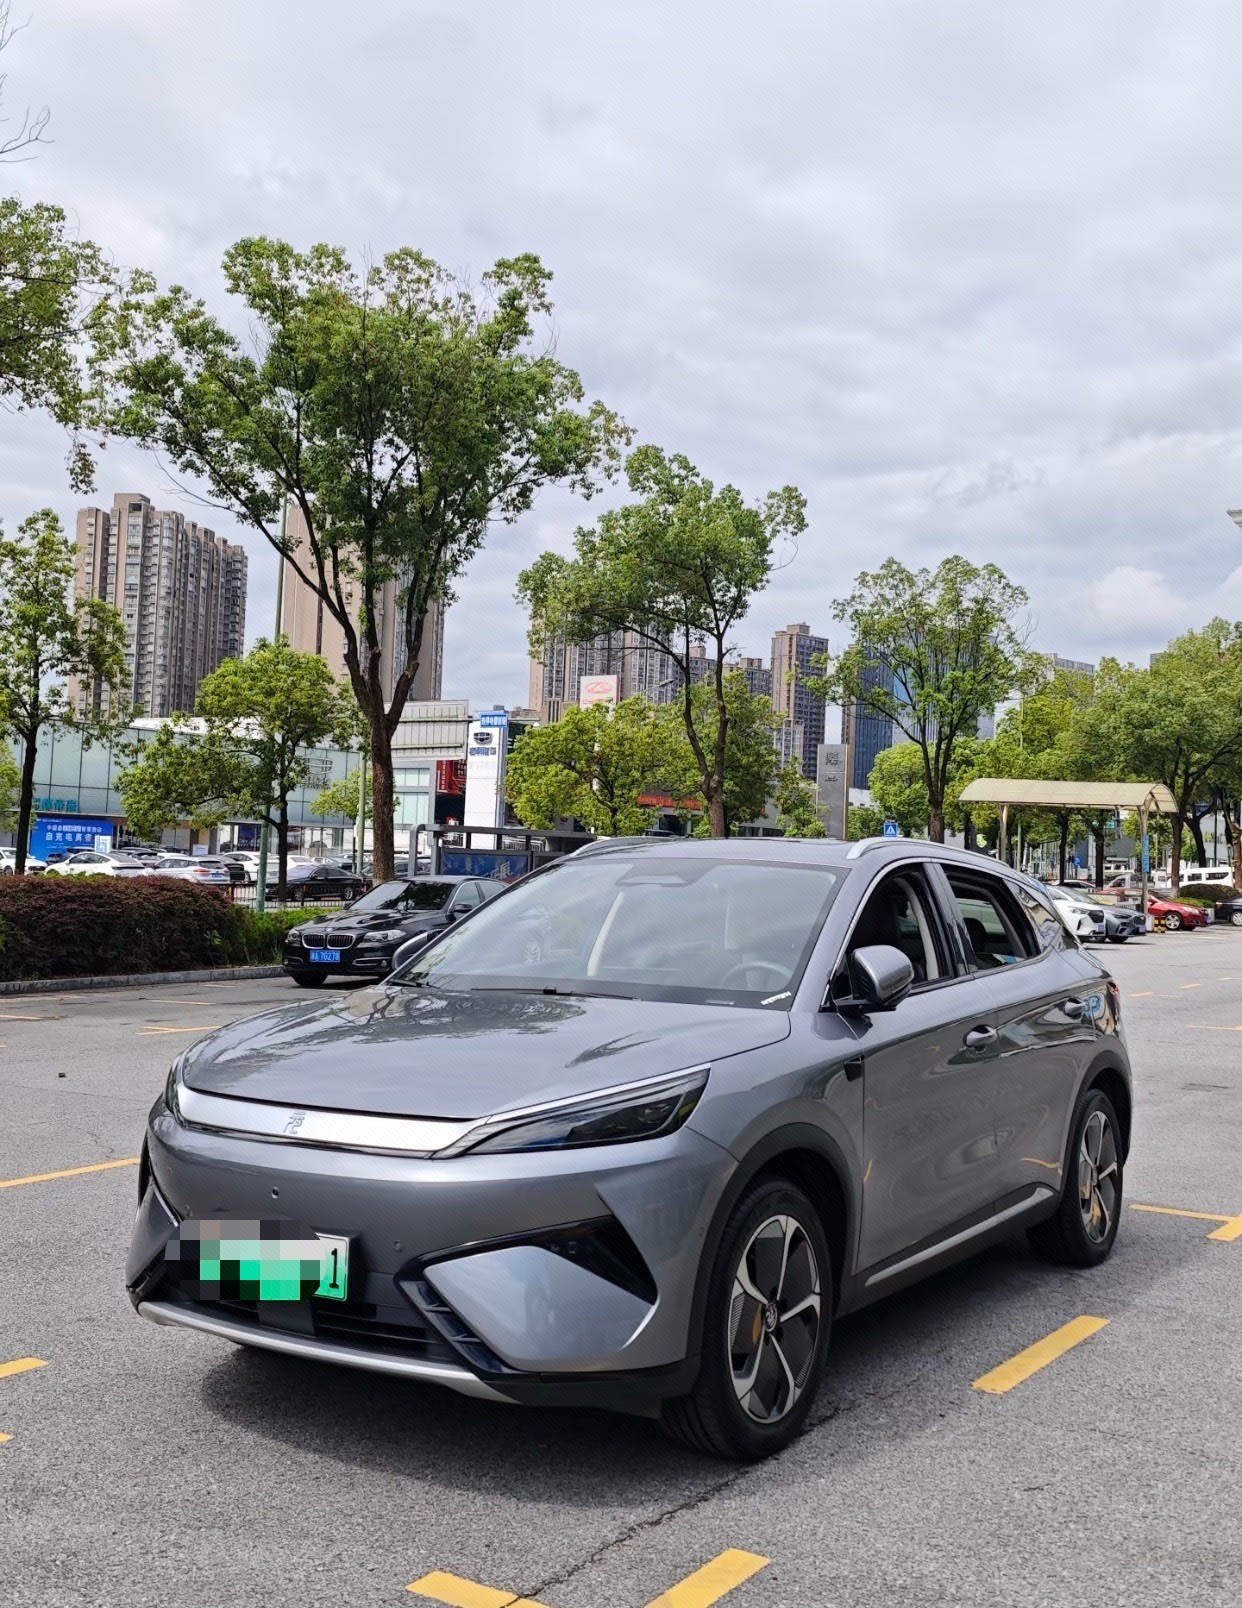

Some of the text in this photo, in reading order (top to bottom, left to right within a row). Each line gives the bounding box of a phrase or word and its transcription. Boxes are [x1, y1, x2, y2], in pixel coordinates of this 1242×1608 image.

[45, 832, 99, 842] 自充电真省
